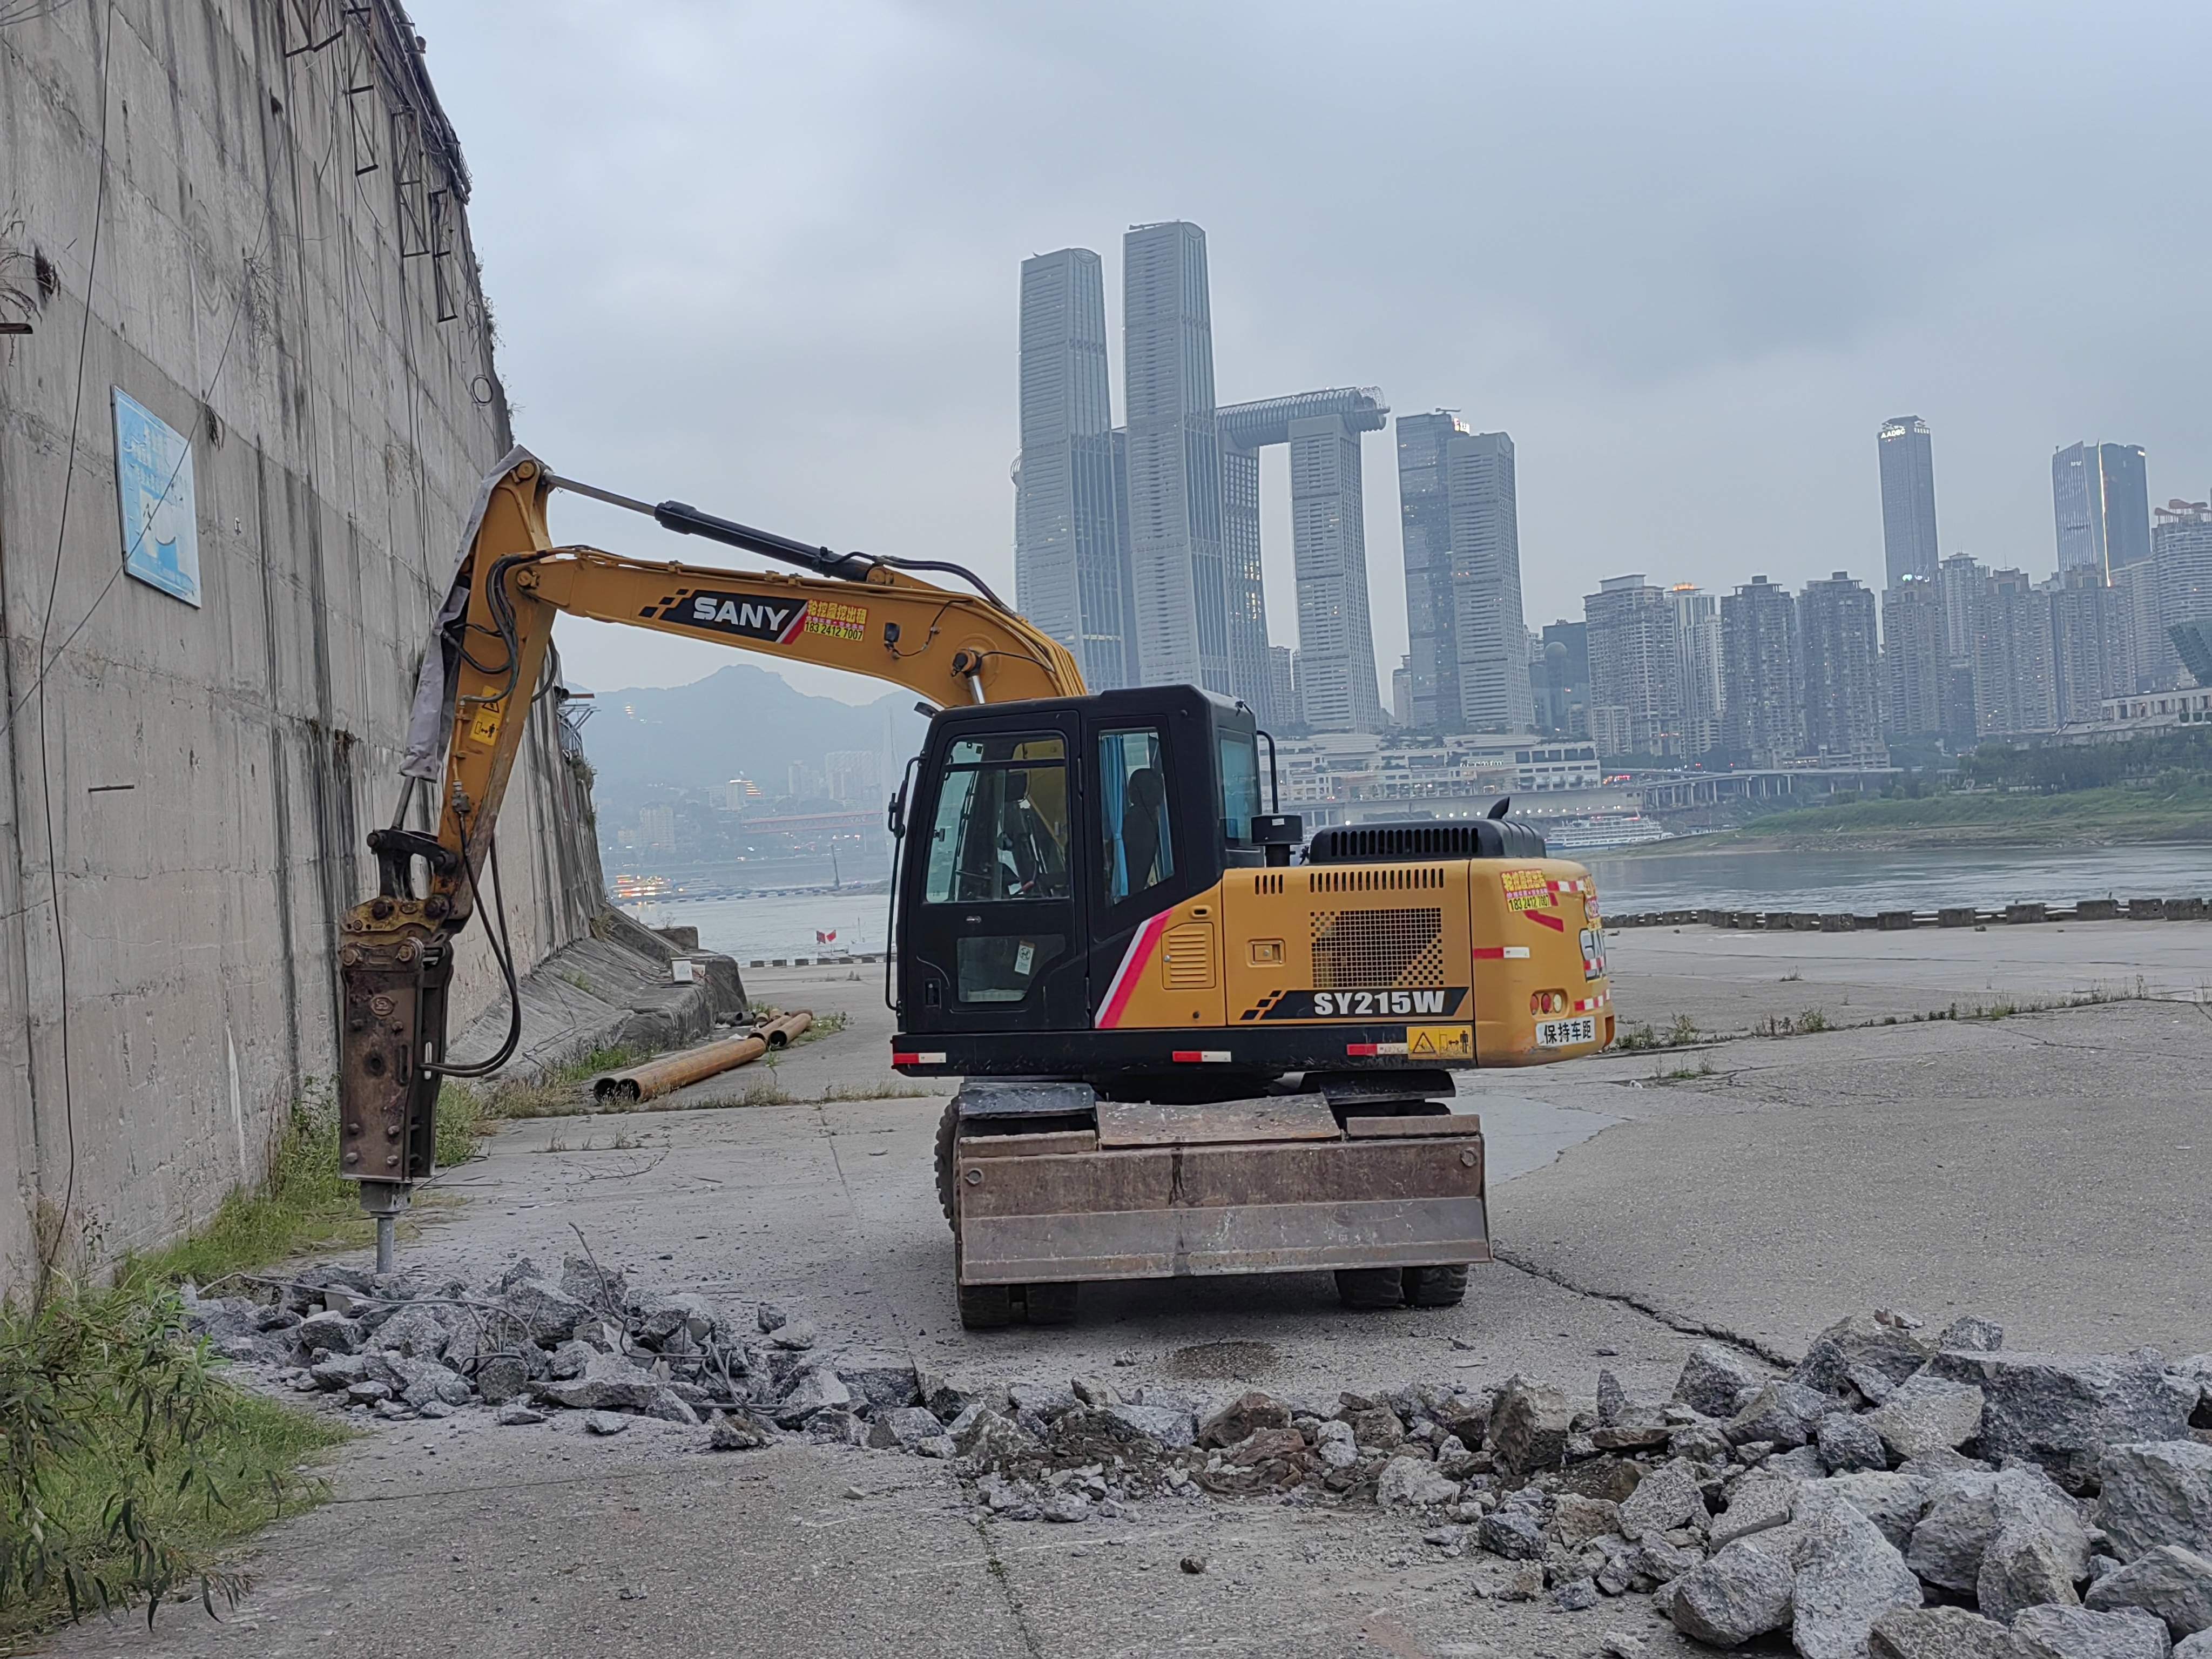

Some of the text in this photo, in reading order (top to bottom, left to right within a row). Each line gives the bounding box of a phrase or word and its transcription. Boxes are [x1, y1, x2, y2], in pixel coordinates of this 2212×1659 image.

[693, 597, 789, 631] SANY
[805, 622, 819, 632] 183
[821, 625, 841, 637] 2412
[844, 628, 862, 640] 7007
[1509, 898, 1522, 911] 183
[1314, 990, 1445, 1015] SY215W
[1544, 1020, 1591, 1044] 保持车距
